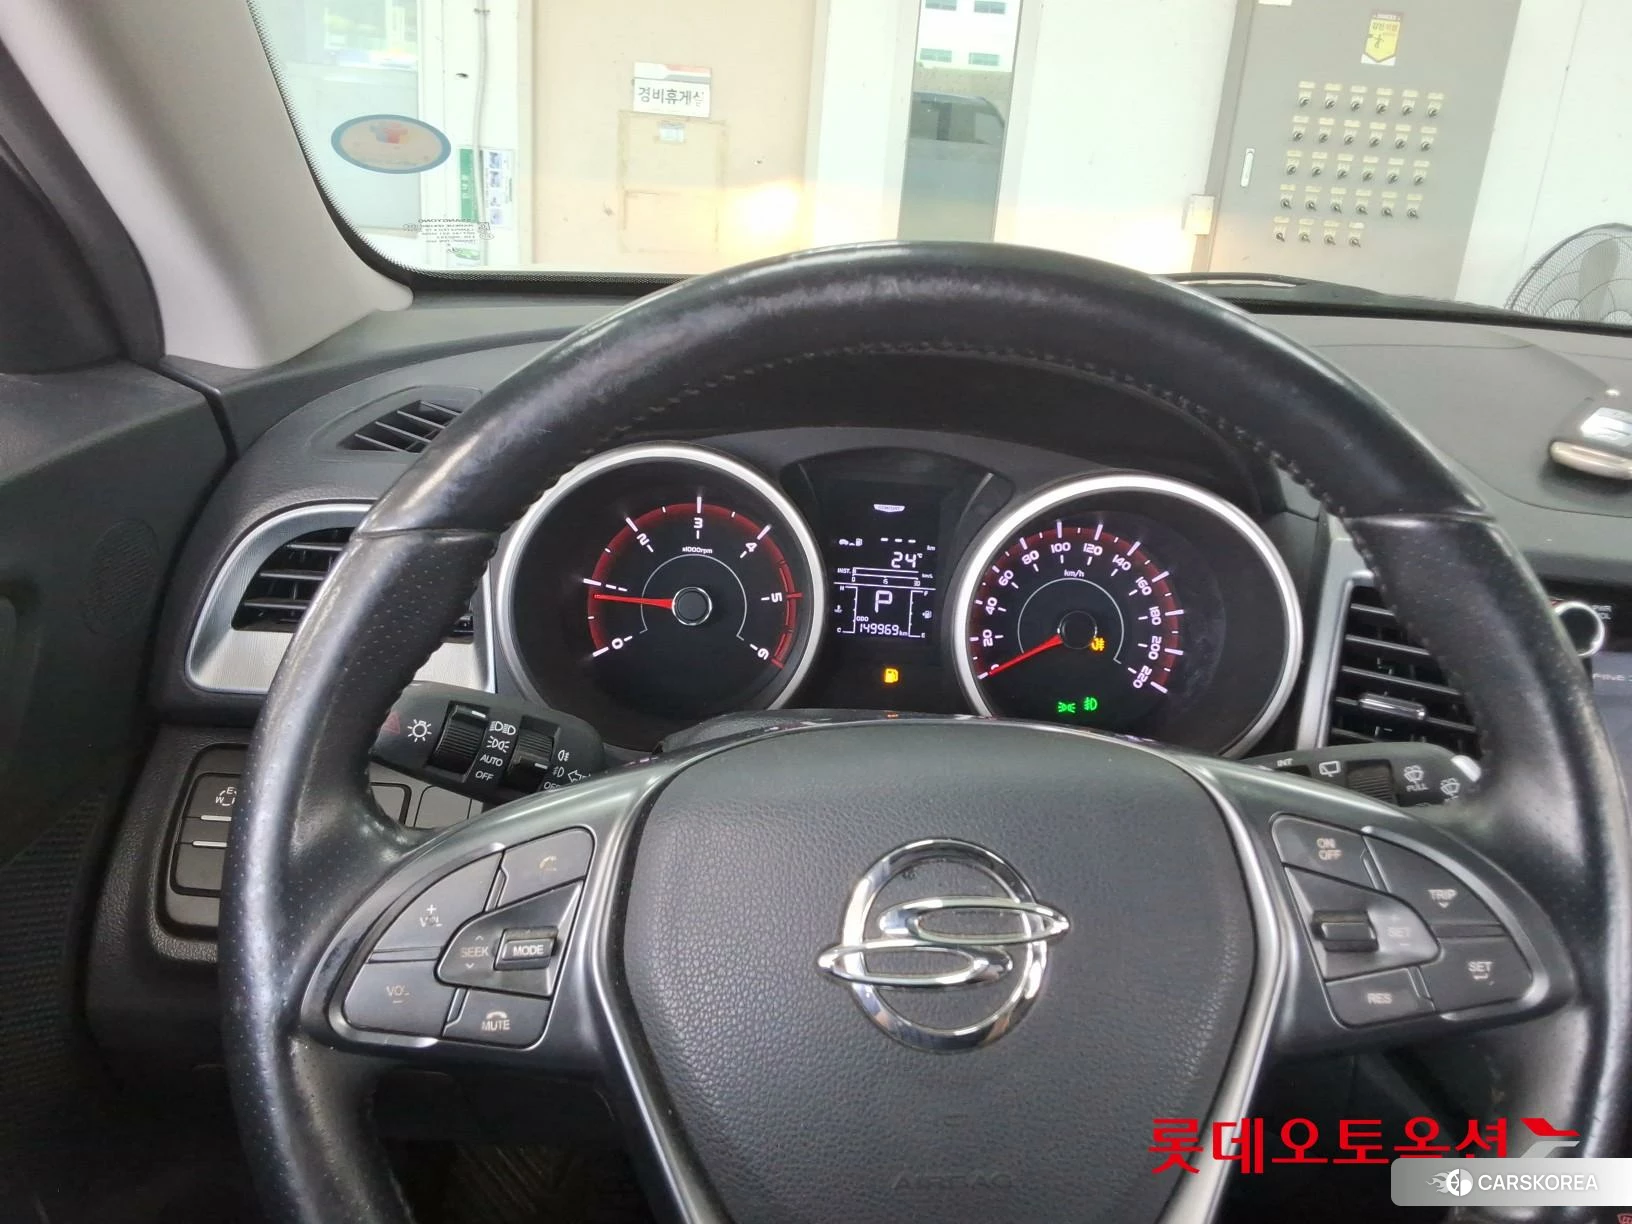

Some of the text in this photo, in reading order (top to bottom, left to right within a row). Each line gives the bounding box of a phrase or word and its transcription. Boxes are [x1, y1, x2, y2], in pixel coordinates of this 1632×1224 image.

[638, 87, 704, 106] 경비휴게실
[694, 517, 703, 529] 3
[636, 533, 650, 546] 2
[745, 541, 757, 553] 4
[1051, 541, 1071, 554] 100
[1083, 543, 1103, 556] 120
[1021, 551, 1040, 566] 80
[1112, 554, 1132, 571] 140
[998, 570, 1014, 586] 60
[1063, 569, 1085, 578] km/h
[1135, 576, 1152, 596] 160
[770, 592, 782, 603] 5
[875, 590, 893, 613] P
[985, 597, 998, 616] 40
[1149, 606, 1162, 626] 180
[611, 638, 624, 650] 0
[983, 629, 994, 647] 20
[757, 648, 769, 660] 6
[1148, 636, 1162, 660] 200
[1133, 665, 1152, 689] 220
[480, 754, 504, 767] AUTO
[475, 770, 494, 782] OFF
[1427, 888, 1457, 901] TRIP
[460, 946, 489, 958] SEEK
[512, 944, 544, 956] MODE
[1467, 961, 1493, 973] SET
[1366, 992, 1393, 1004] RES
[481, 1020, 511, 1032] MUTE
